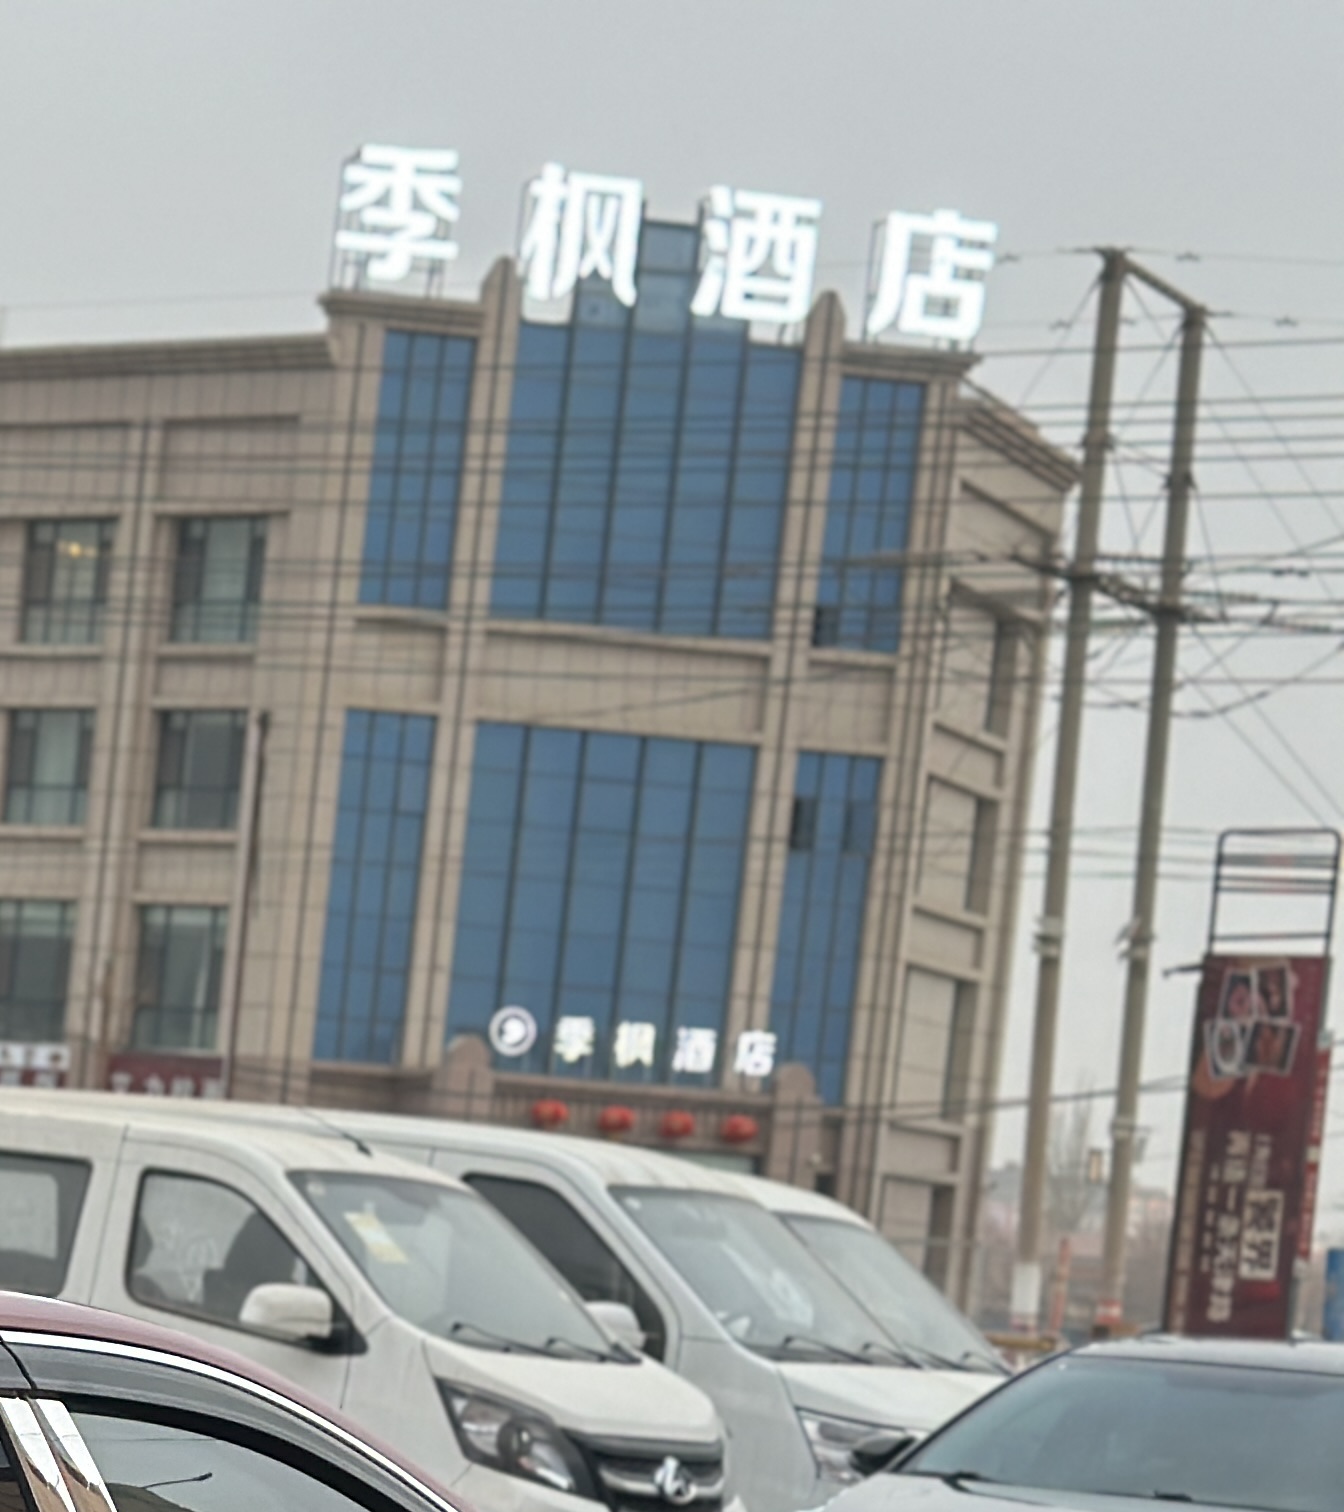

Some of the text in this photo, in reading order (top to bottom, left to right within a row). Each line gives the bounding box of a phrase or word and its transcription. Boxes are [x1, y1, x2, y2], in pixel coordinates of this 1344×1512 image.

[336, 142, 998, 340] 季枫酒店
[553, 1016, 777, 1076] 季枫酒店
